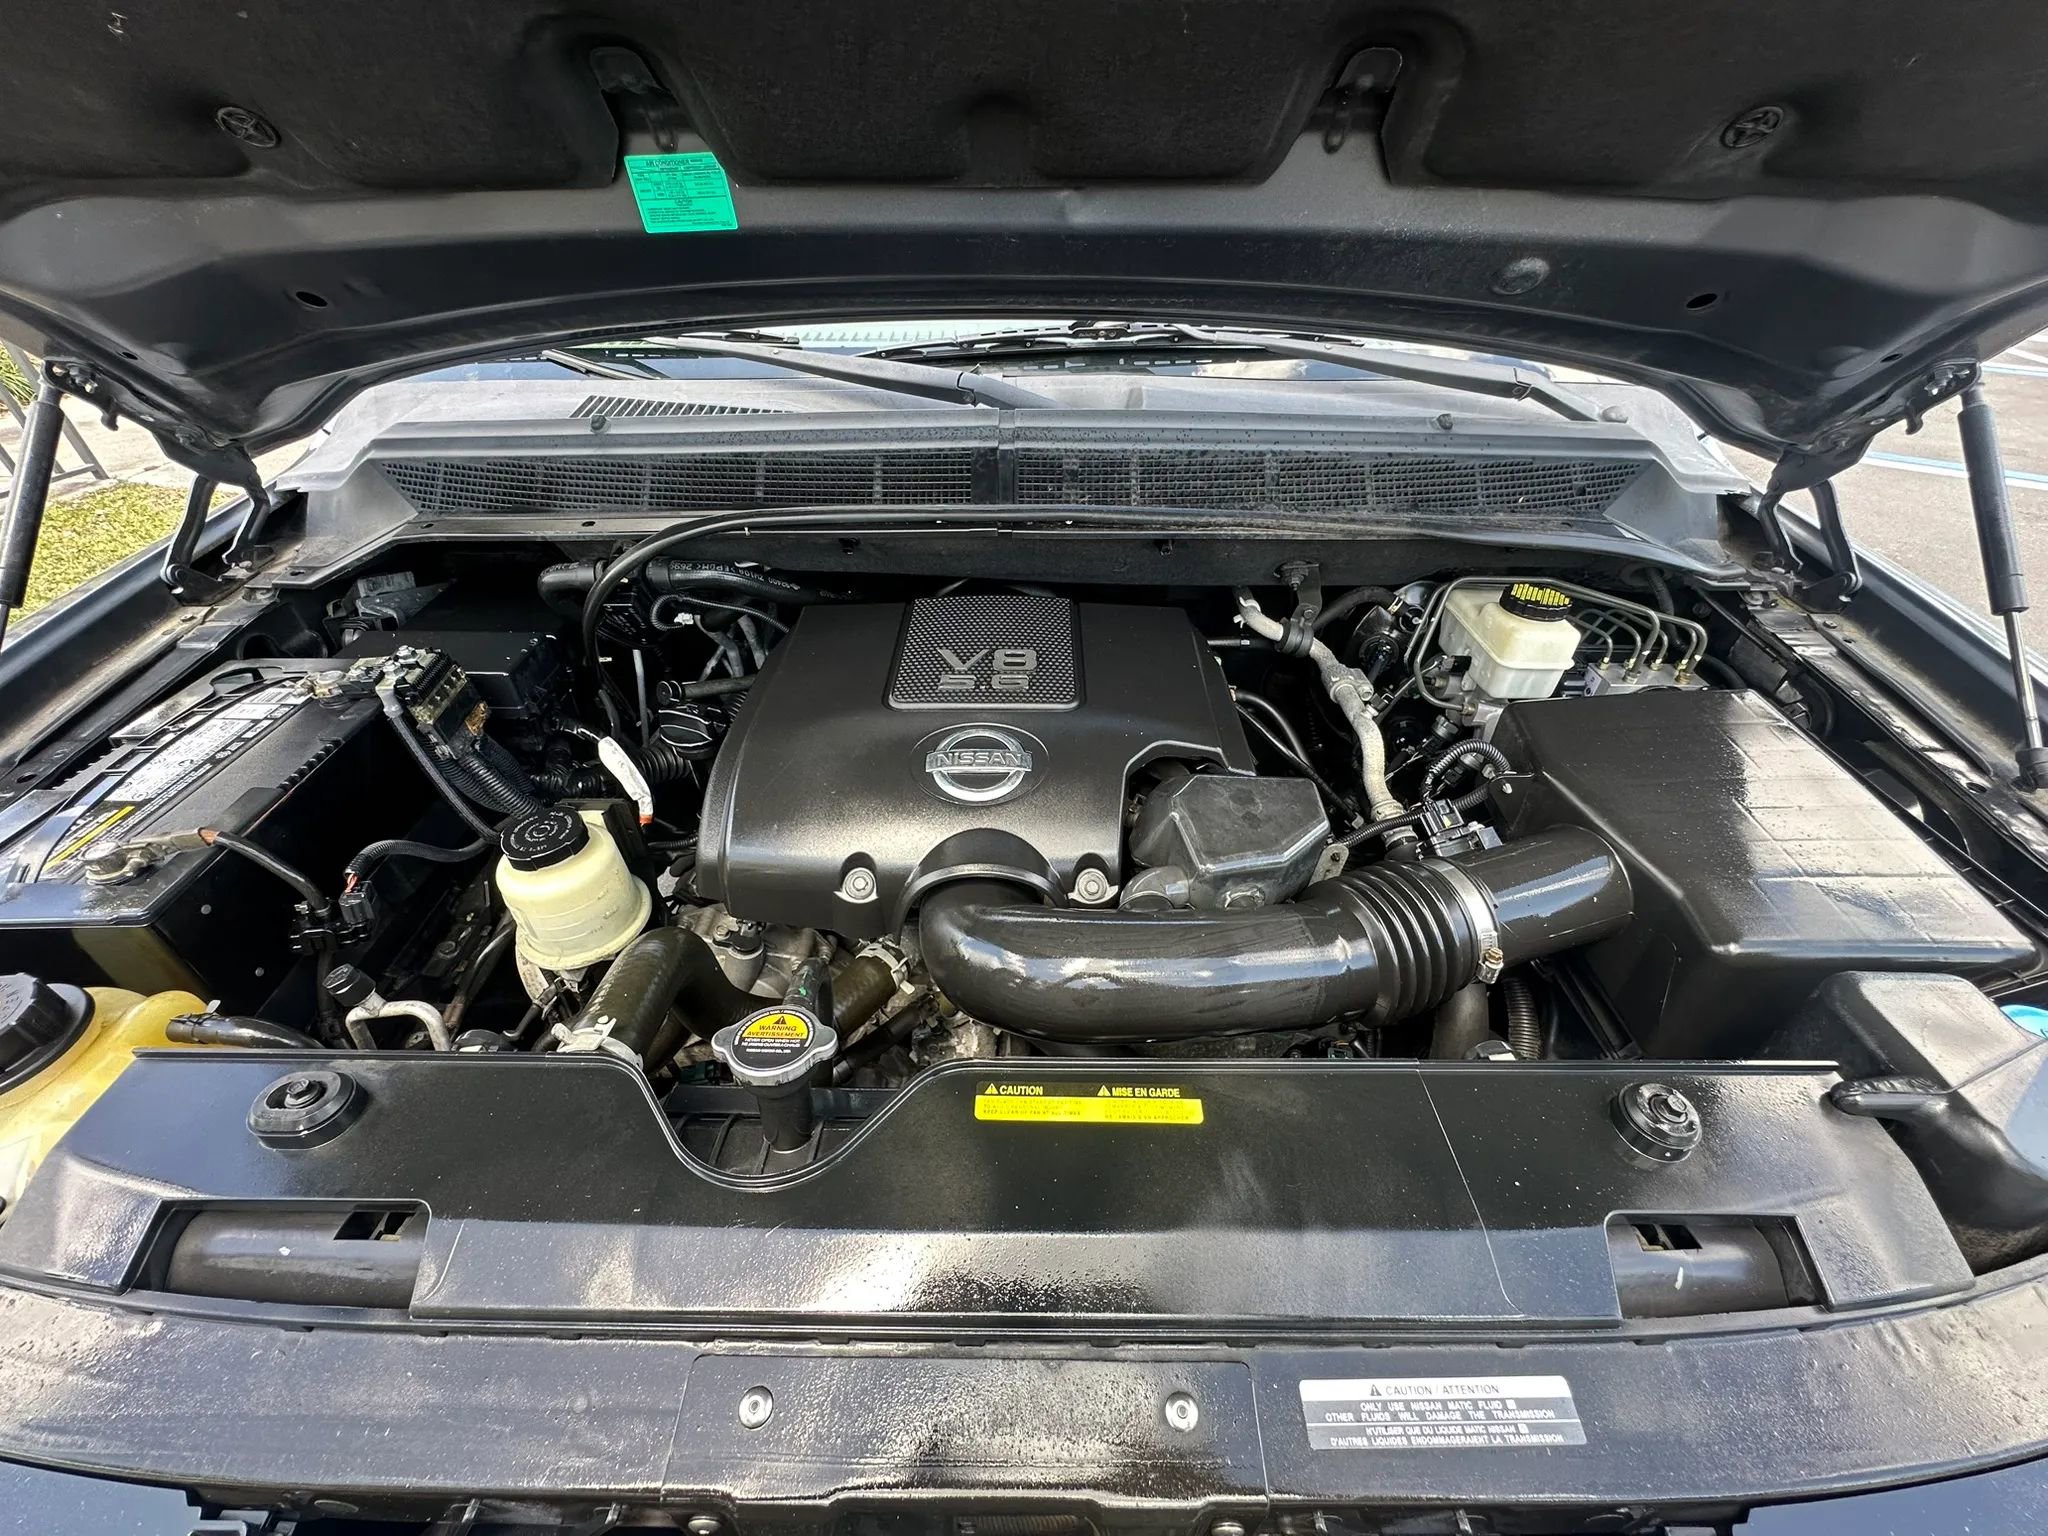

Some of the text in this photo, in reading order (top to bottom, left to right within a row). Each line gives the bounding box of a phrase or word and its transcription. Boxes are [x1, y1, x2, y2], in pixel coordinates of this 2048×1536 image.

[936, 648, 1038, 671] V8
[938, 674, 1030, 690] 5.6
[936, 752, 1022, 766] NISSAN
[1000, 1085, 1043, 1095] CAUTION
[1112, 1087, 1180, 1097] MISE EN GARDE
[1385, 1386, 1432, 1395] CAUTION
[1443, 1385, 1500, 1394] ATTENTION
[1360, 1402, 1381, 1411] ONLY
[1387, 1402, 1405, 1411] USE
[1410, 1401, 1442, 1411] NISSAN
[1447, 1401, 1473, 1410] MATIC
[1477, 1400, 1502, 1410] FLUID
[1325, 1409, 1555, 1422] OTHER FLUIDS WILL DAMAGE THE TRANSMISSION
[1405, 1426, 1421, 1435] QUE
[1422, 1426, 1434, 1435] DU
[1434, 1425, 1463, 1435] LIQUIDE
[1463, 1425, 1487, 1434] MATIC
[1487, 1424, 1516, 1434] NISSAN
[1330, 1437, 1368, 1446] D'AUTRES
[1371, 1436, 1407, 1446] LIQUIDES
[1489, 1435, 1503, 1444] LA
[1504, 1434, 1564, 1444] TRANSMISSION
